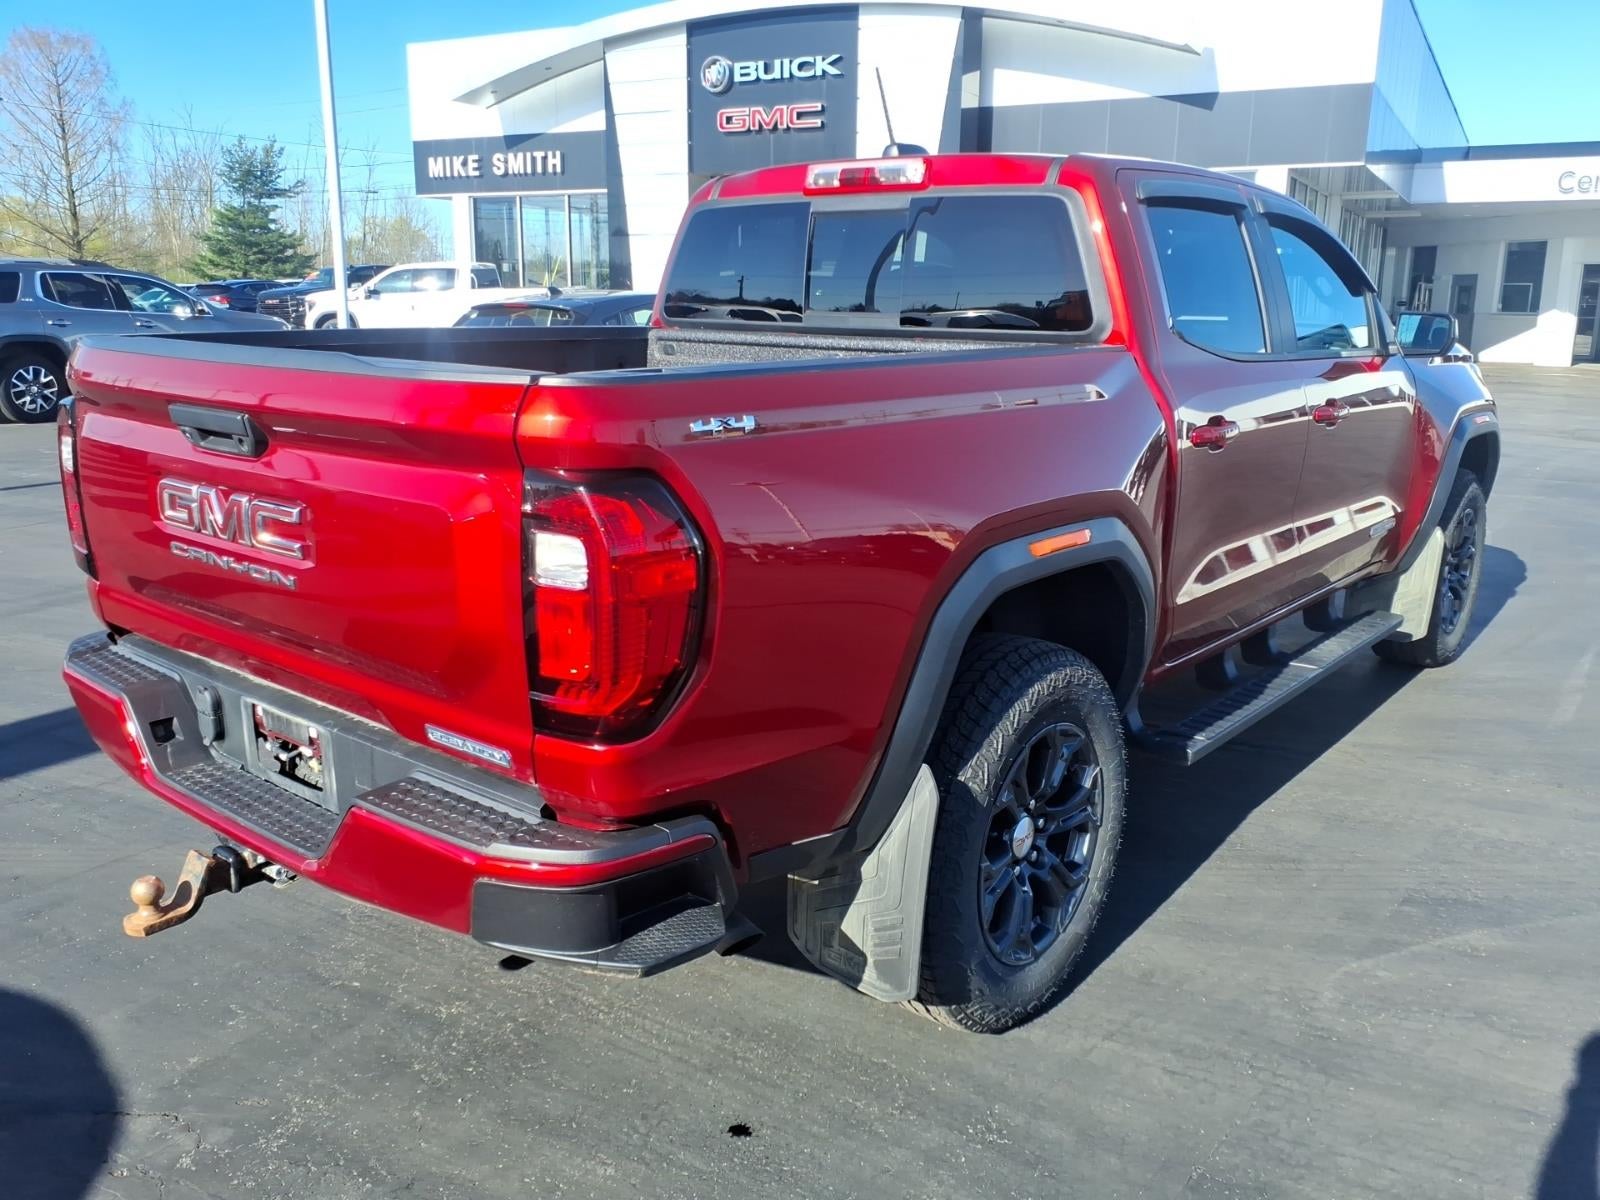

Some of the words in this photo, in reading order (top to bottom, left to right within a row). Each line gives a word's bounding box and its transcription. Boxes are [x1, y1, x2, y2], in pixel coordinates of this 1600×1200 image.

[733, 54, 842, 83] BUICK
[717, 102, 823, 132] GMC
[427, 154, 480, 178] MIKE
[491, 150, 562, 176] SMITH
[157, 477, 305, 560] GMC
[169, 540, 298, 590] CANYON
